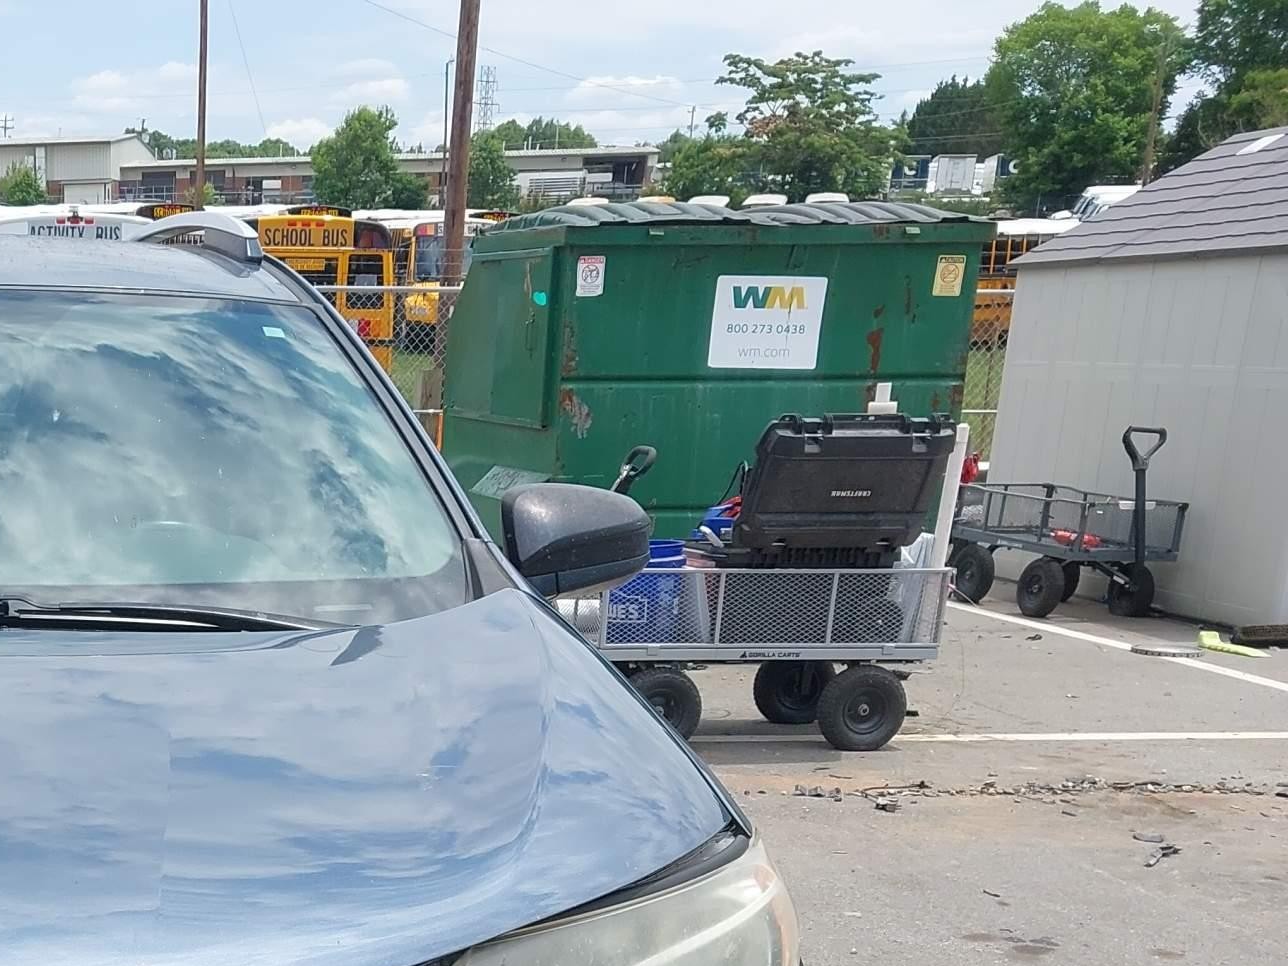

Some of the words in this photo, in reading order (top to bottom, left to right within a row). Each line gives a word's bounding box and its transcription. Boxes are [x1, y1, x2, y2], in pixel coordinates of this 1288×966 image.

[95, 225, 121, 241] BUS
[264, 228, 314, 246] SCHOOL
[322, 229, 348, 246] BUS
[733, 286, 805, 309] WM
[727, 323, 748, 334] 800
[752, 324, 772, 334] 273
[776, 324, 805, 335] 0438
[738, 346, 790, 358] wm.com
